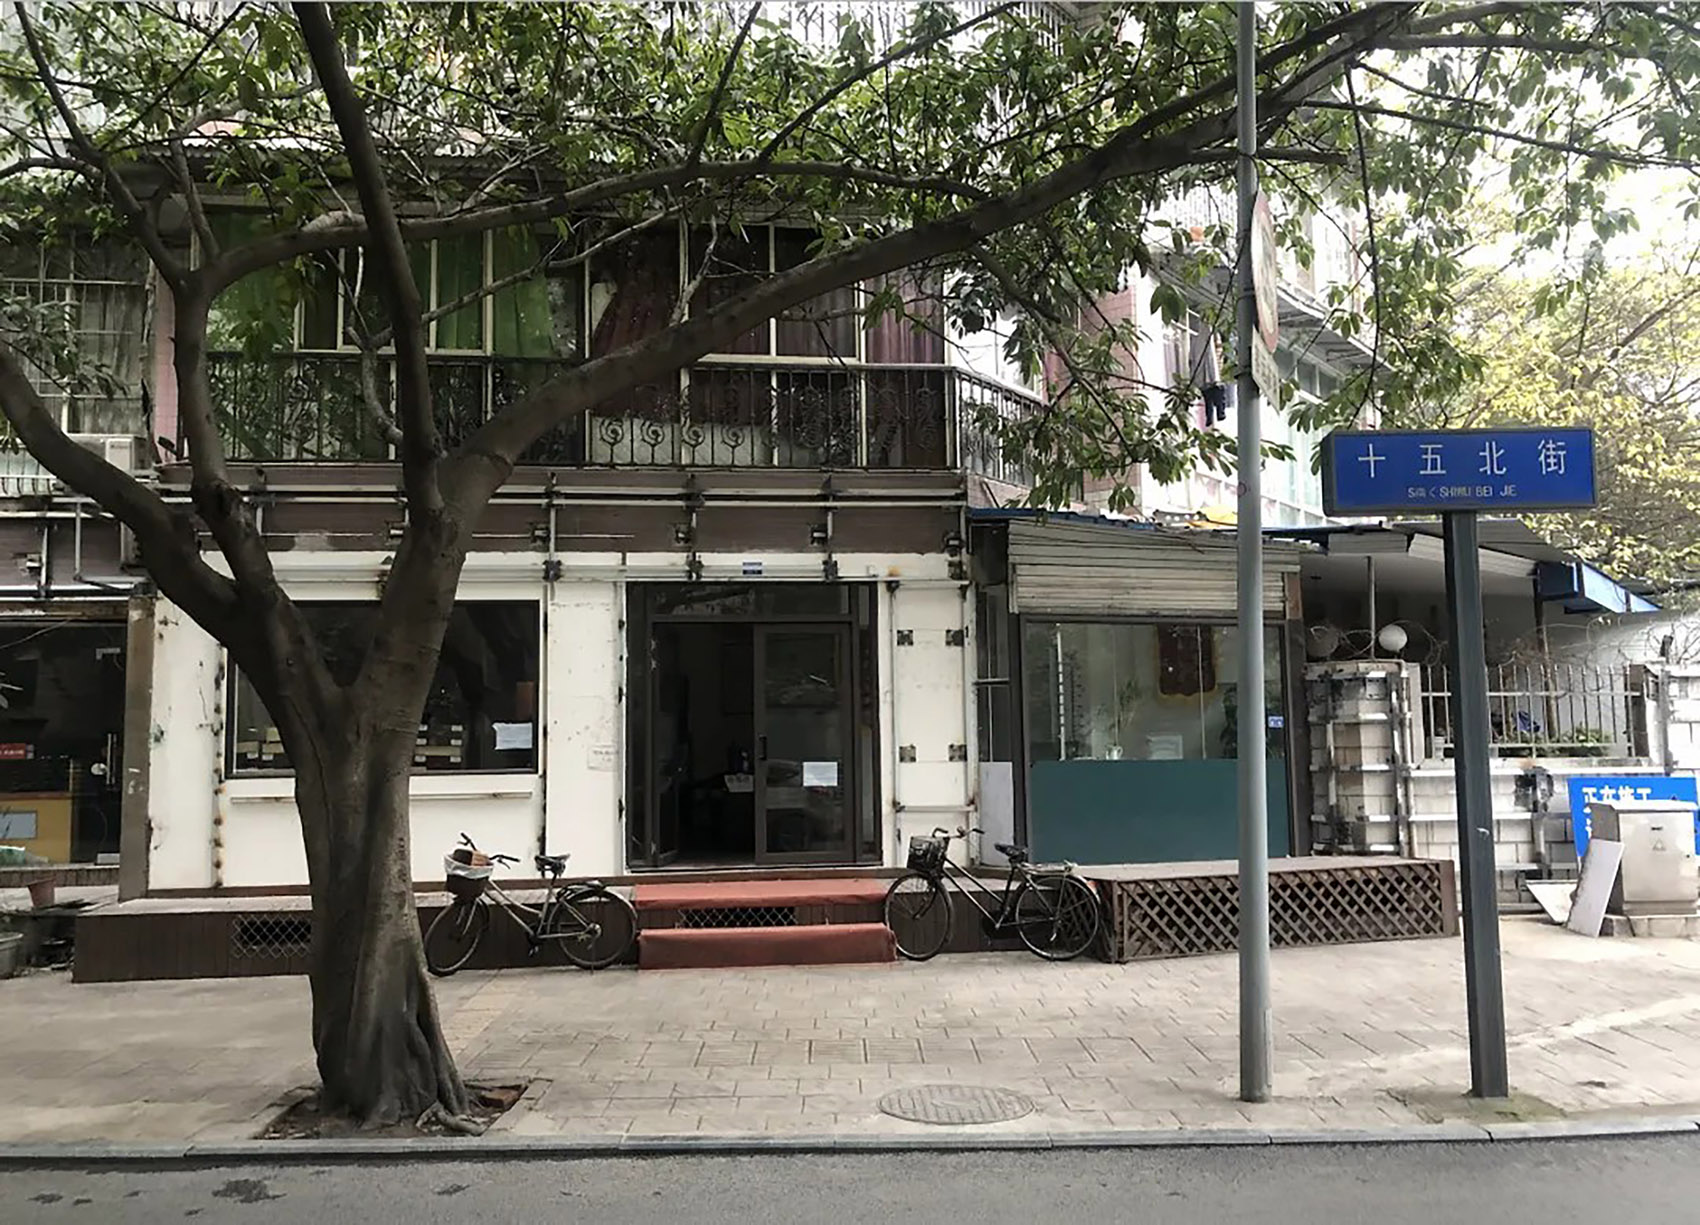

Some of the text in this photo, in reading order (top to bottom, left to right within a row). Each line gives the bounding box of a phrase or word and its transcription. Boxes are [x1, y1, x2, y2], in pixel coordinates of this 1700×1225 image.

[1358, 439, 1567, 478] 十五北街
[1475, 485, 1493, 497] BEI
